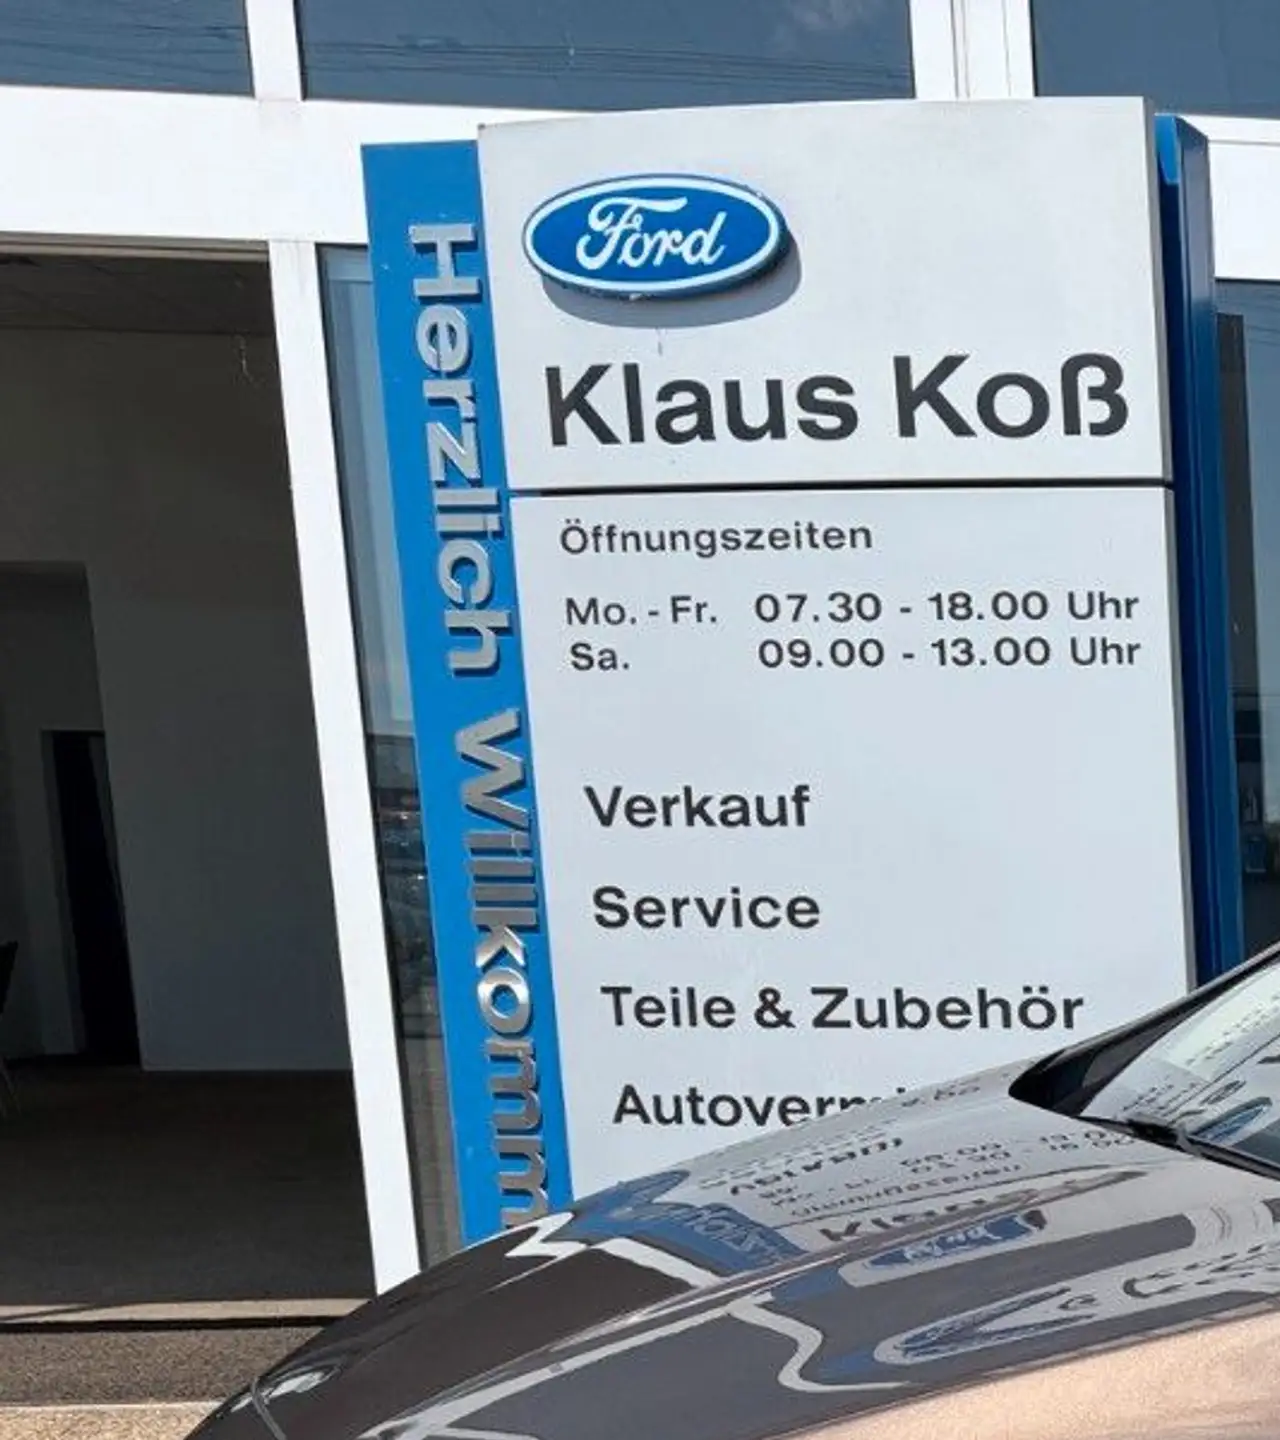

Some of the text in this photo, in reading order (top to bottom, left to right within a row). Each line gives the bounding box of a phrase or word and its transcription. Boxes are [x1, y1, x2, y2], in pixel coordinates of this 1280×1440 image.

[576, 195, 728, 270] Ford
[545, 352, 1129, 447] Klaus Koß
[408, 222, 513, 676] Herzlich
[560, 518, 872, 559] Öffnungszeiten
[566, 597, 637, 627] Mo.
[670, 595, 718, 623] Fr.
[755, 592, 882, 623] 07.30
[927, 591, 1048, 621] 18.00
[1067, 591, 1139, 620] Uhr
[570, 642, 630, 671] Sa.
[758, 638, 885, 669] 09.00
[931, 636, 1051, 667] 13.00
[1070, 637, 1141, 666] Uhr
[583, 784, 810, 828] Verkauf
[593, 885, 820, 929] Service
[600, 985, 1085, 1029] Teile & Zubehör
[612, 1083, 906, 1128] Autover
